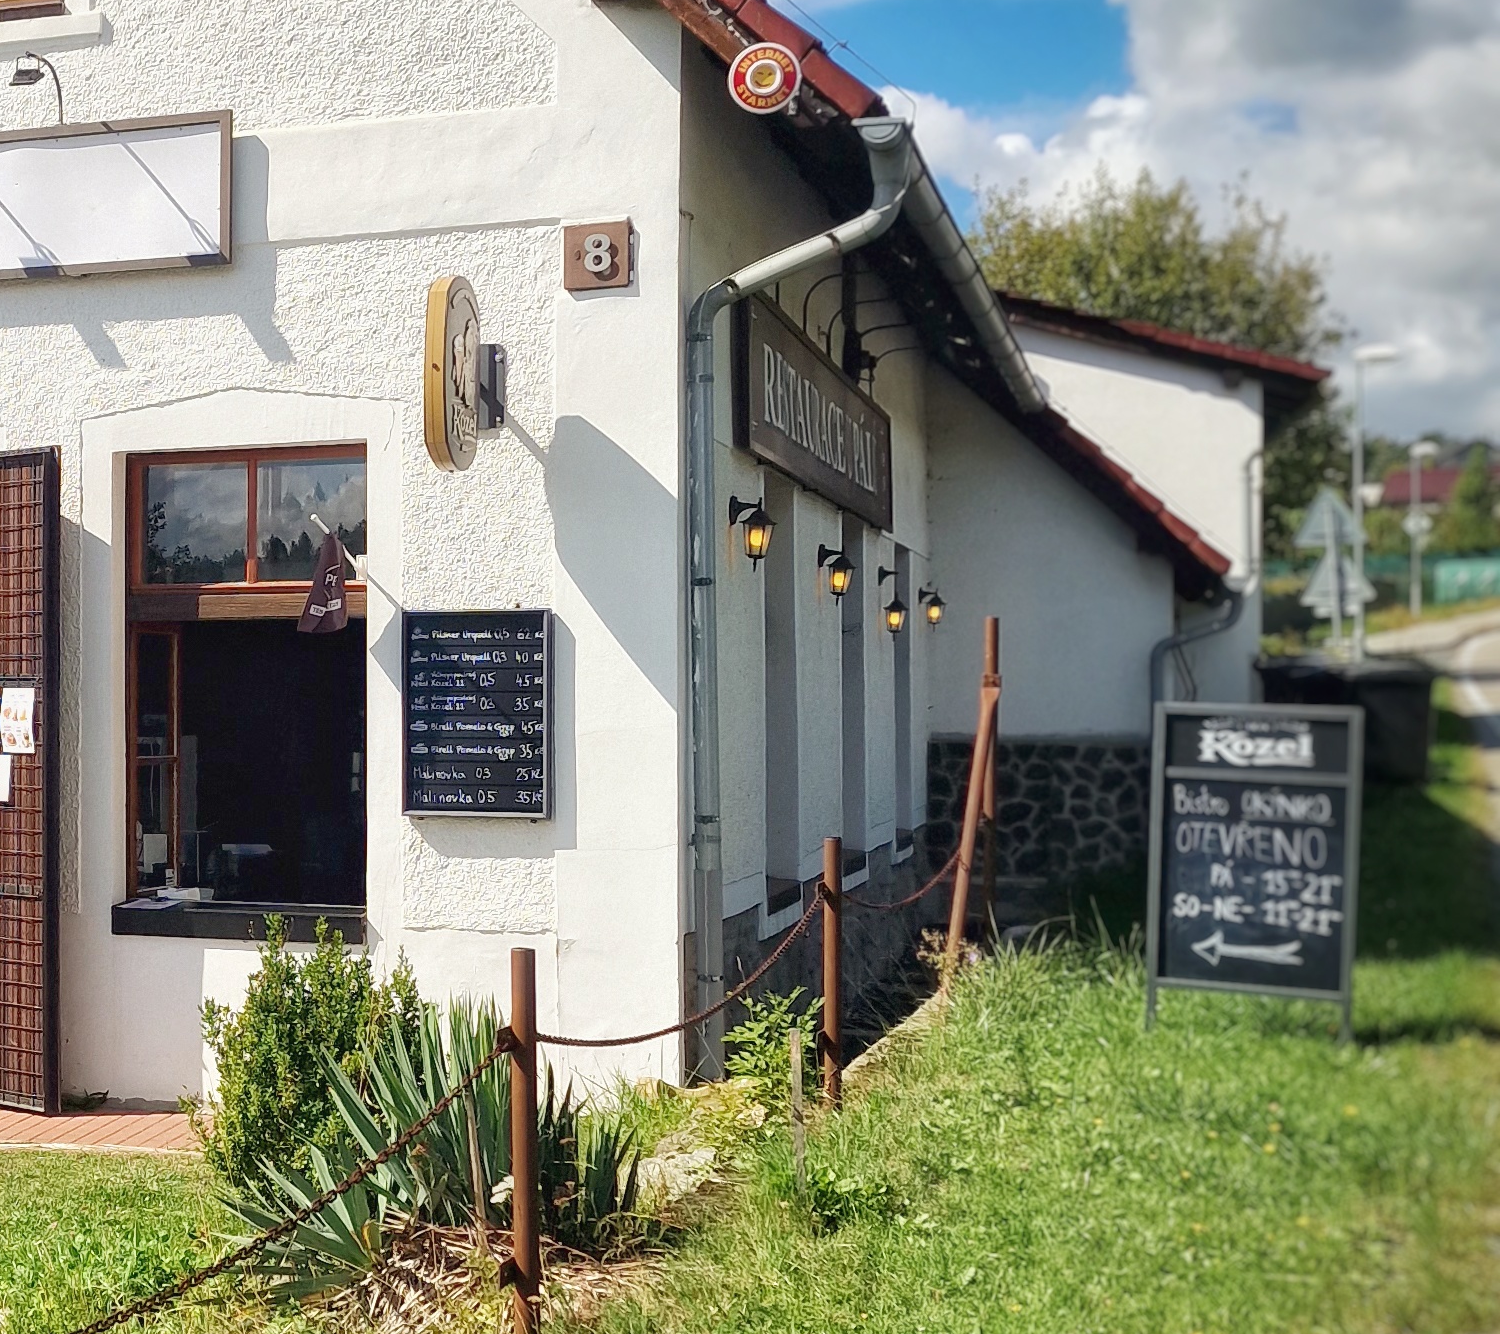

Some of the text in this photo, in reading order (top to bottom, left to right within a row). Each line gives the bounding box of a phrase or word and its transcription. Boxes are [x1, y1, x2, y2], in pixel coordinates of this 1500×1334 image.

[738, 49, 794, 73] INTERNET
[736, 84, 790, 107] STARNET
[584, 233, 612, 273] 8
[763, 343, 846, 474] RESTAURACE
[452, 404, 478, 441] Kozel
[516, 673, 532, 687] 45
[514, 697, 531, 711] 35
[521, 720, 537, 735] 45
[520, 743, 534, 759] 35
[1197, 729, 1315, 767] Kozel
[413, 766, 466, 780] Malinovka
[516, 767, 533, 781] 25
[413, 789, 474, 804] Malinovka
[515, 789, 532, 804] 35
[1173, 783, 1230, 817] Bistro
[1176, 819, 1329, 870] OTEVŘENO
